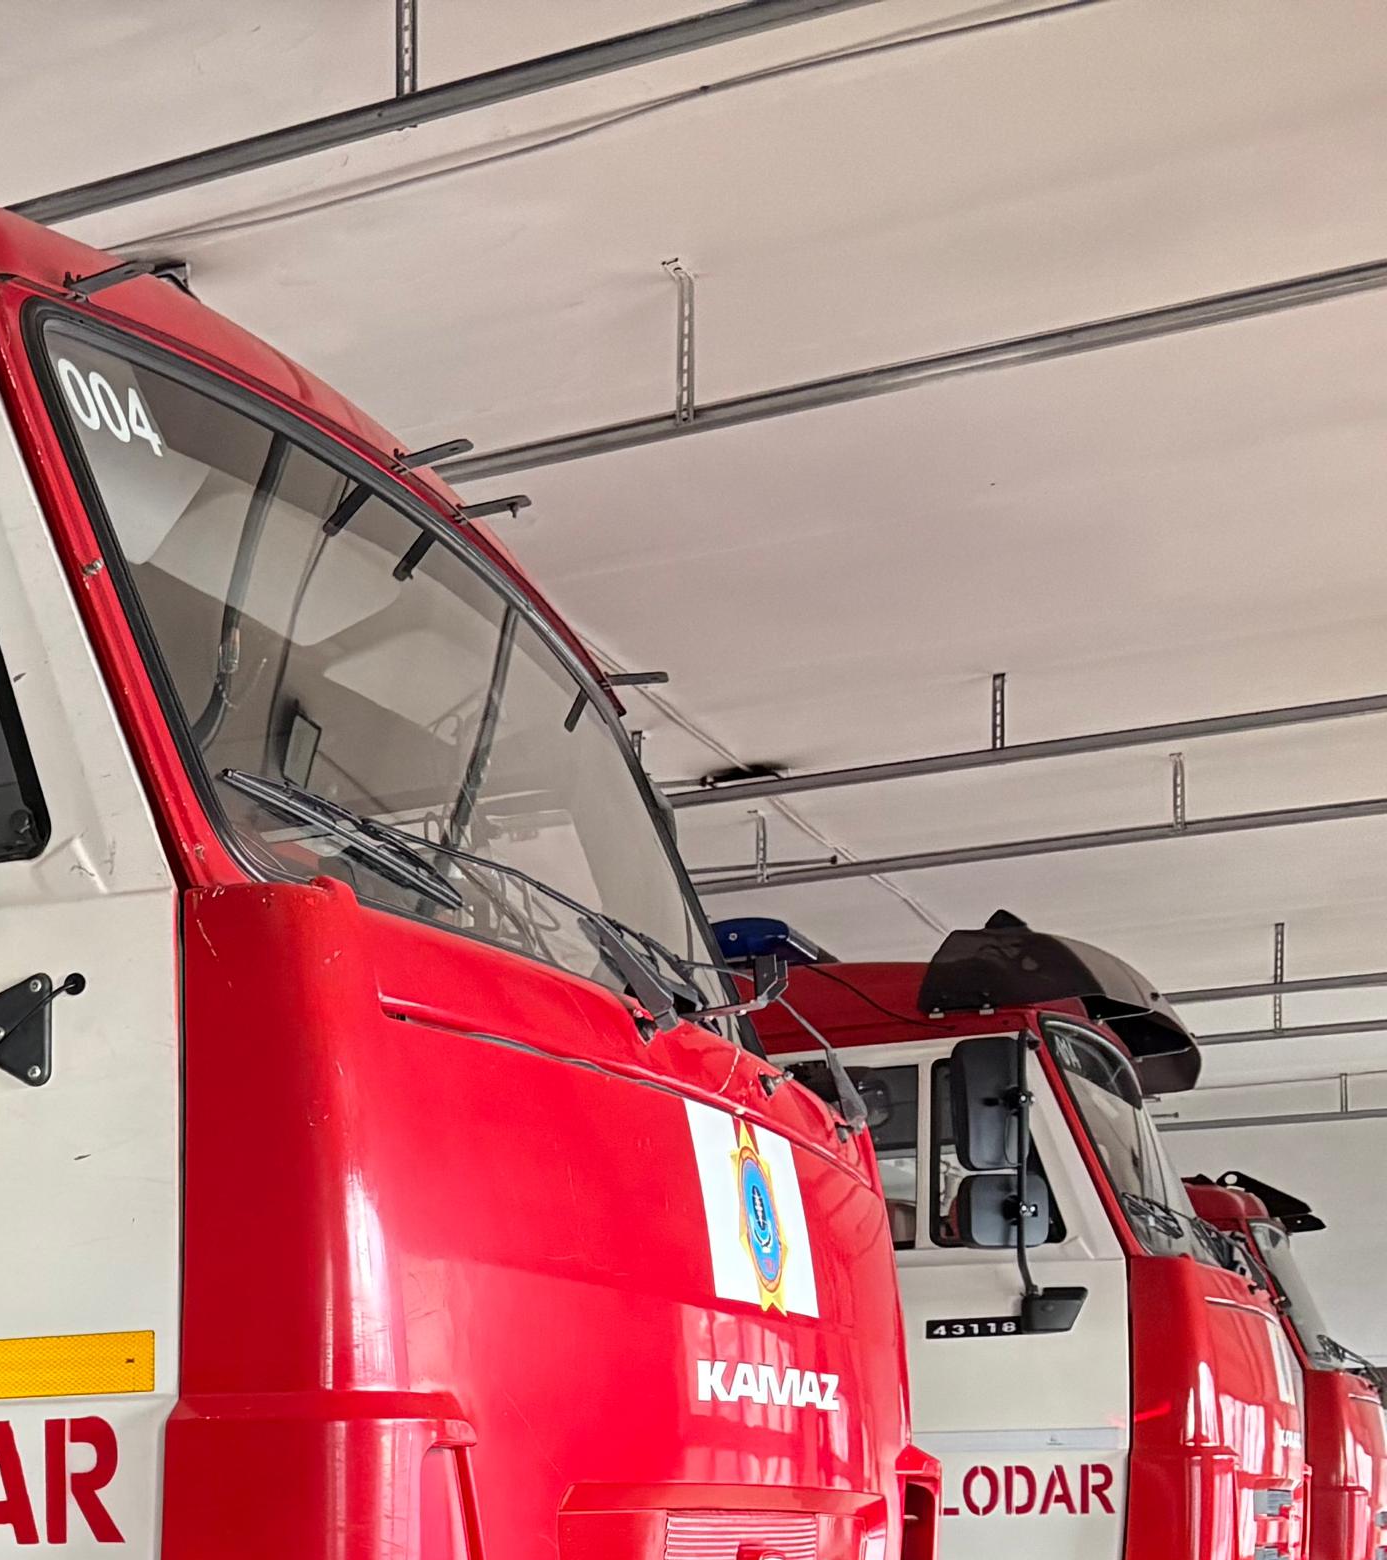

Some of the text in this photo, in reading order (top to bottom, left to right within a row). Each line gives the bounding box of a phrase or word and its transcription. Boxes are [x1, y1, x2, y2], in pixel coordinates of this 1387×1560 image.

[57, 357, 164, 458] 004
[932, 1321, 1017, 1336] 43118
[697, 1360, 840, 1411] KAMAZ
